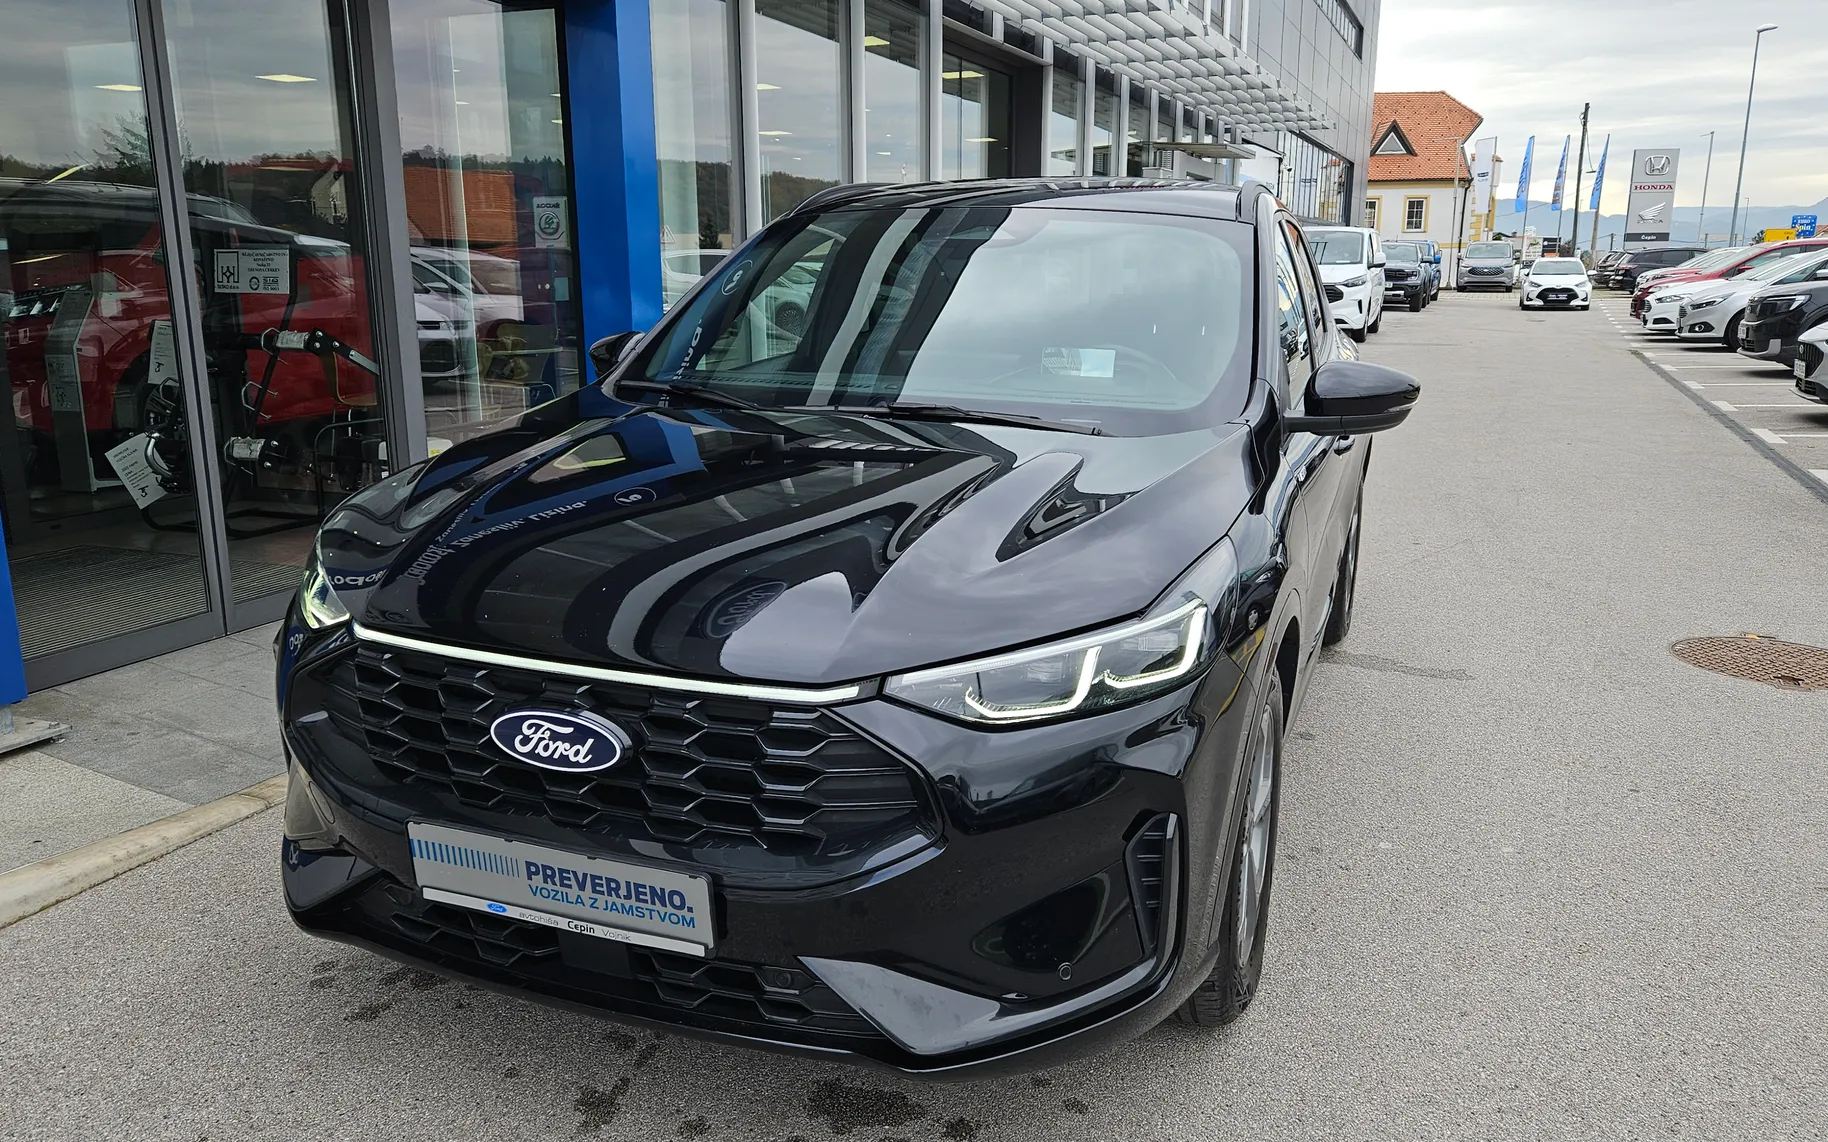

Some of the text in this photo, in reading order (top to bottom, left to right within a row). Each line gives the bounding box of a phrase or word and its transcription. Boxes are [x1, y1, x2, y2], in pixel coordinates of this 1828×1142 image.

[514, 719, 595, 764] Ford
[524, 860, 694, 914] PREVERJENO.
[528, 883, 696, 929] VOZILA Z JAMSTVOM
[519, 911, 559, 926] avtohiša
[601, 928, 632, 941] Vojnik
